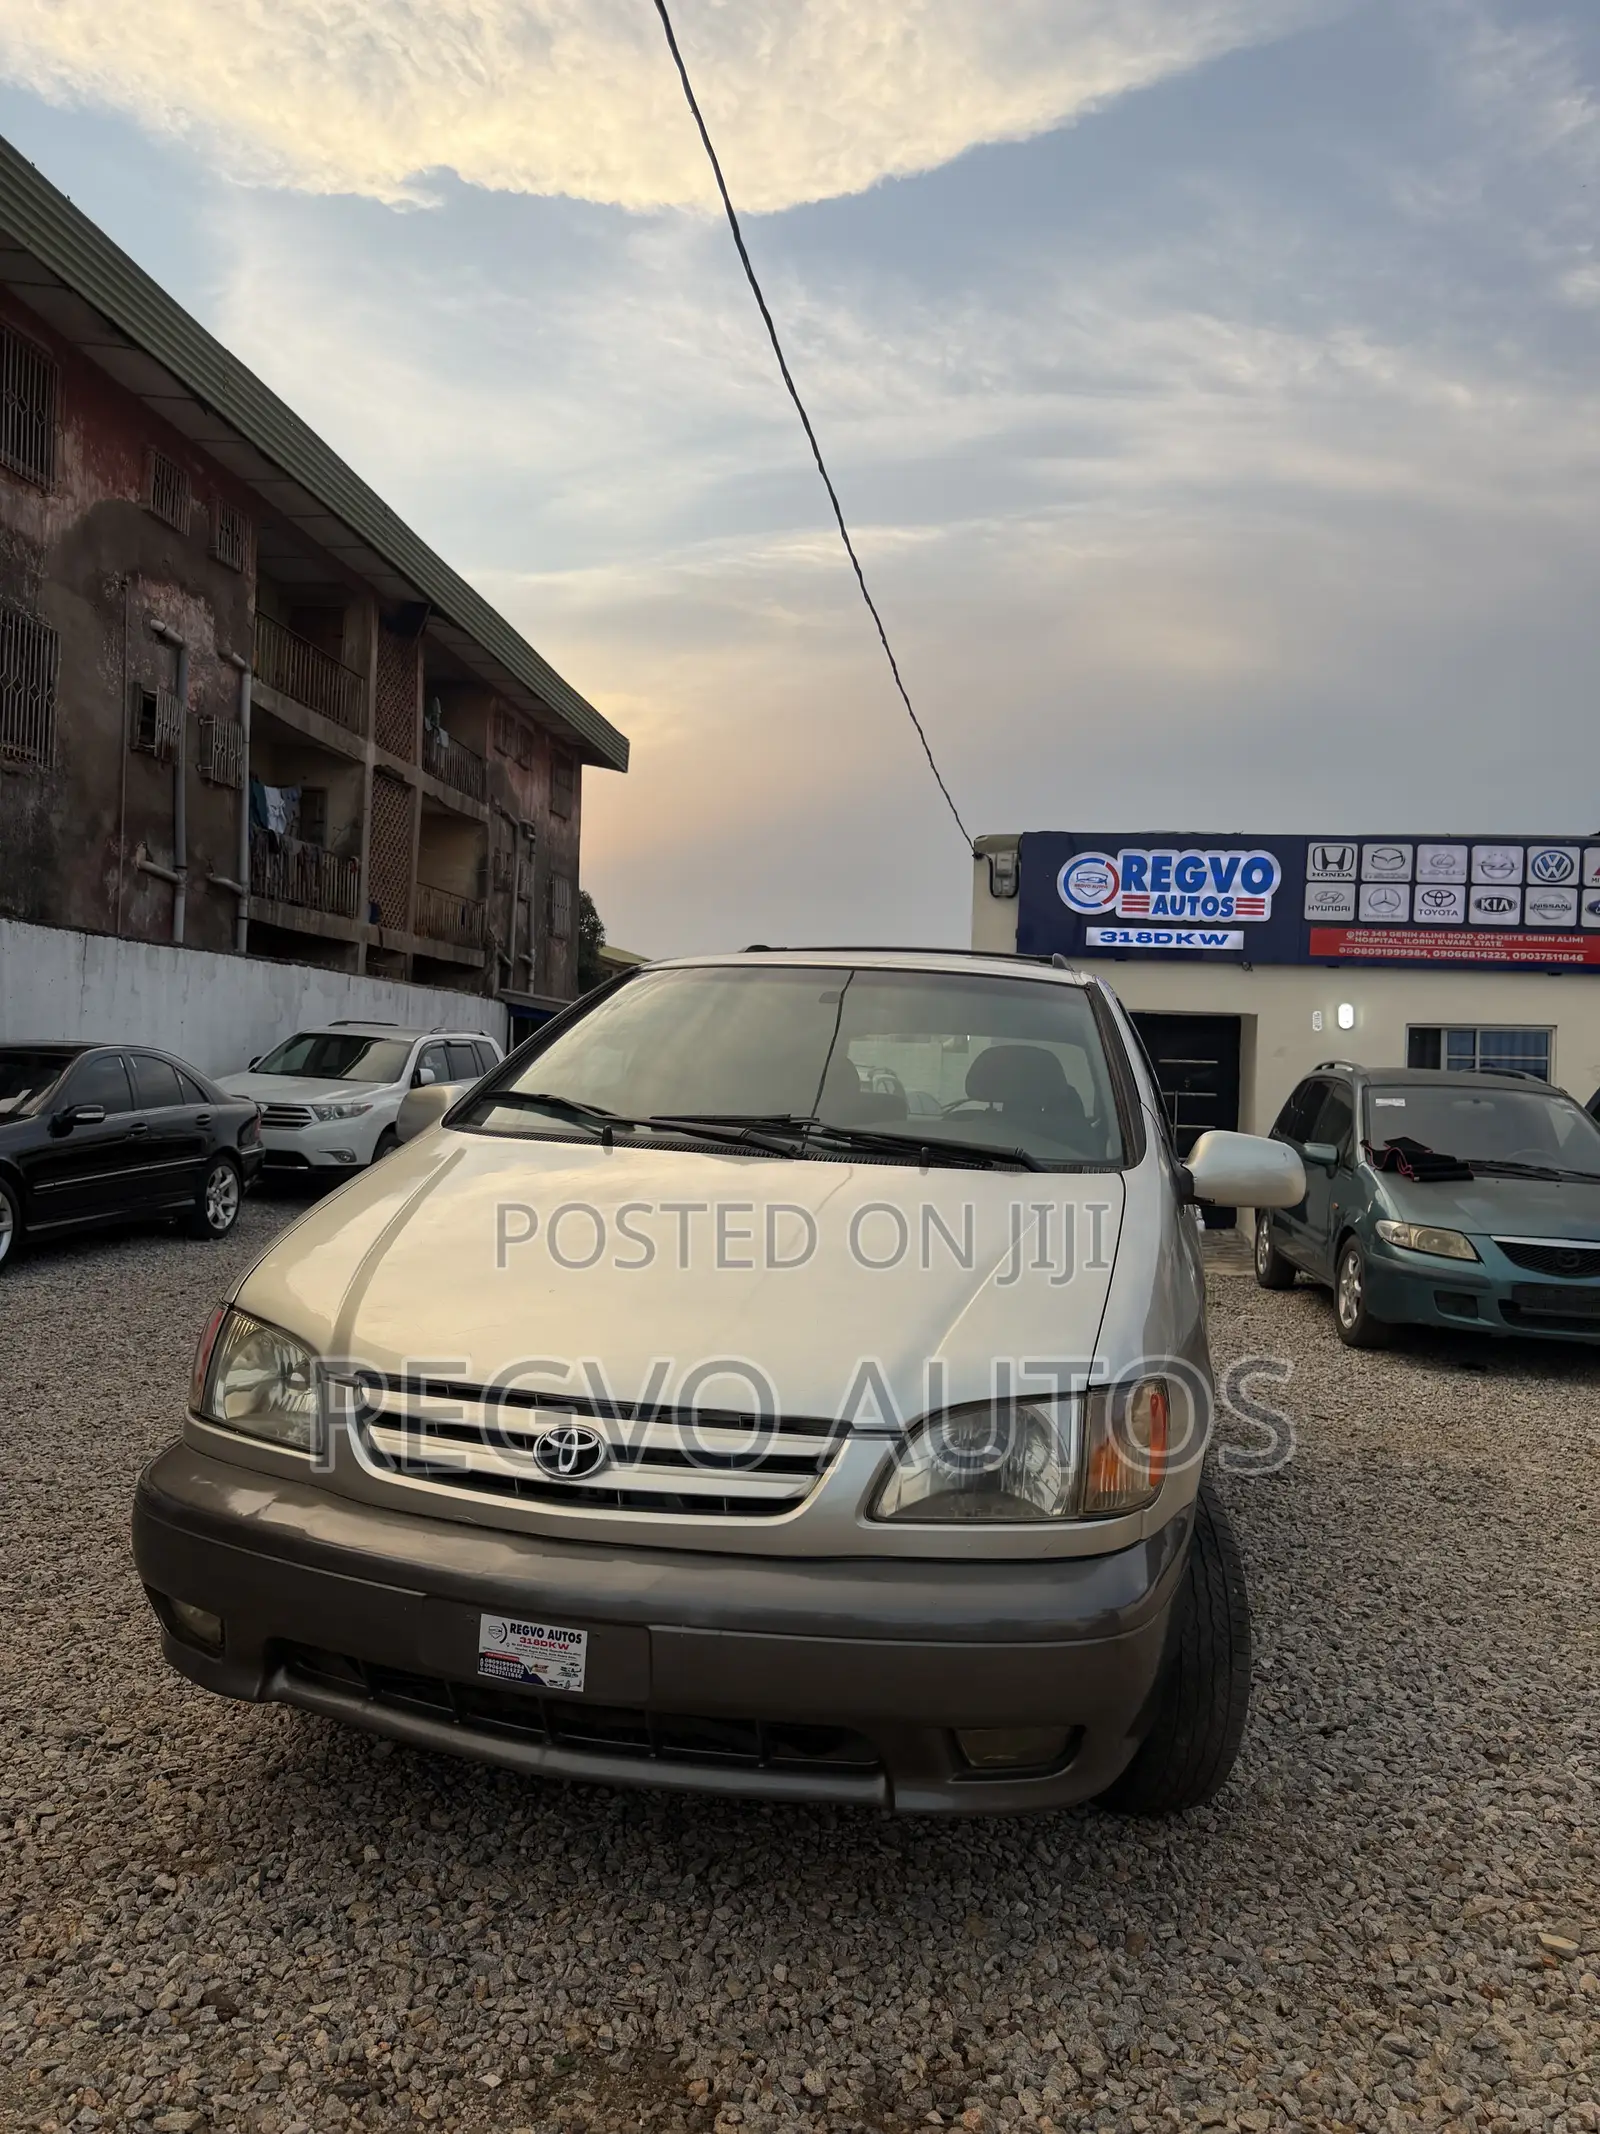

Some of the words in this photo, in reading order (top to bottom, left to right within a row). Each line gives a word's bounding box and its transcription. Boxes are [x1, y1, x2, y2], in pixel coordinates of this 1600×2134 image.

[1121, 855, 1274, 894] REGVO
[1152, 895, 1234, 917] AUTOS
[1308, 904, 1351, 912] HYUNDAI
[1480, 898, 1510, 911] KIA
[1418, 909, 1459, 917] TOYOTA
[1100, 930, 1229, 946] 318DKW
[510, 1623, 545, 1639] REGVO
[547, 1629, 582, 1645] AUTOS
[520, 1636, 569, 1650] 318DKW
